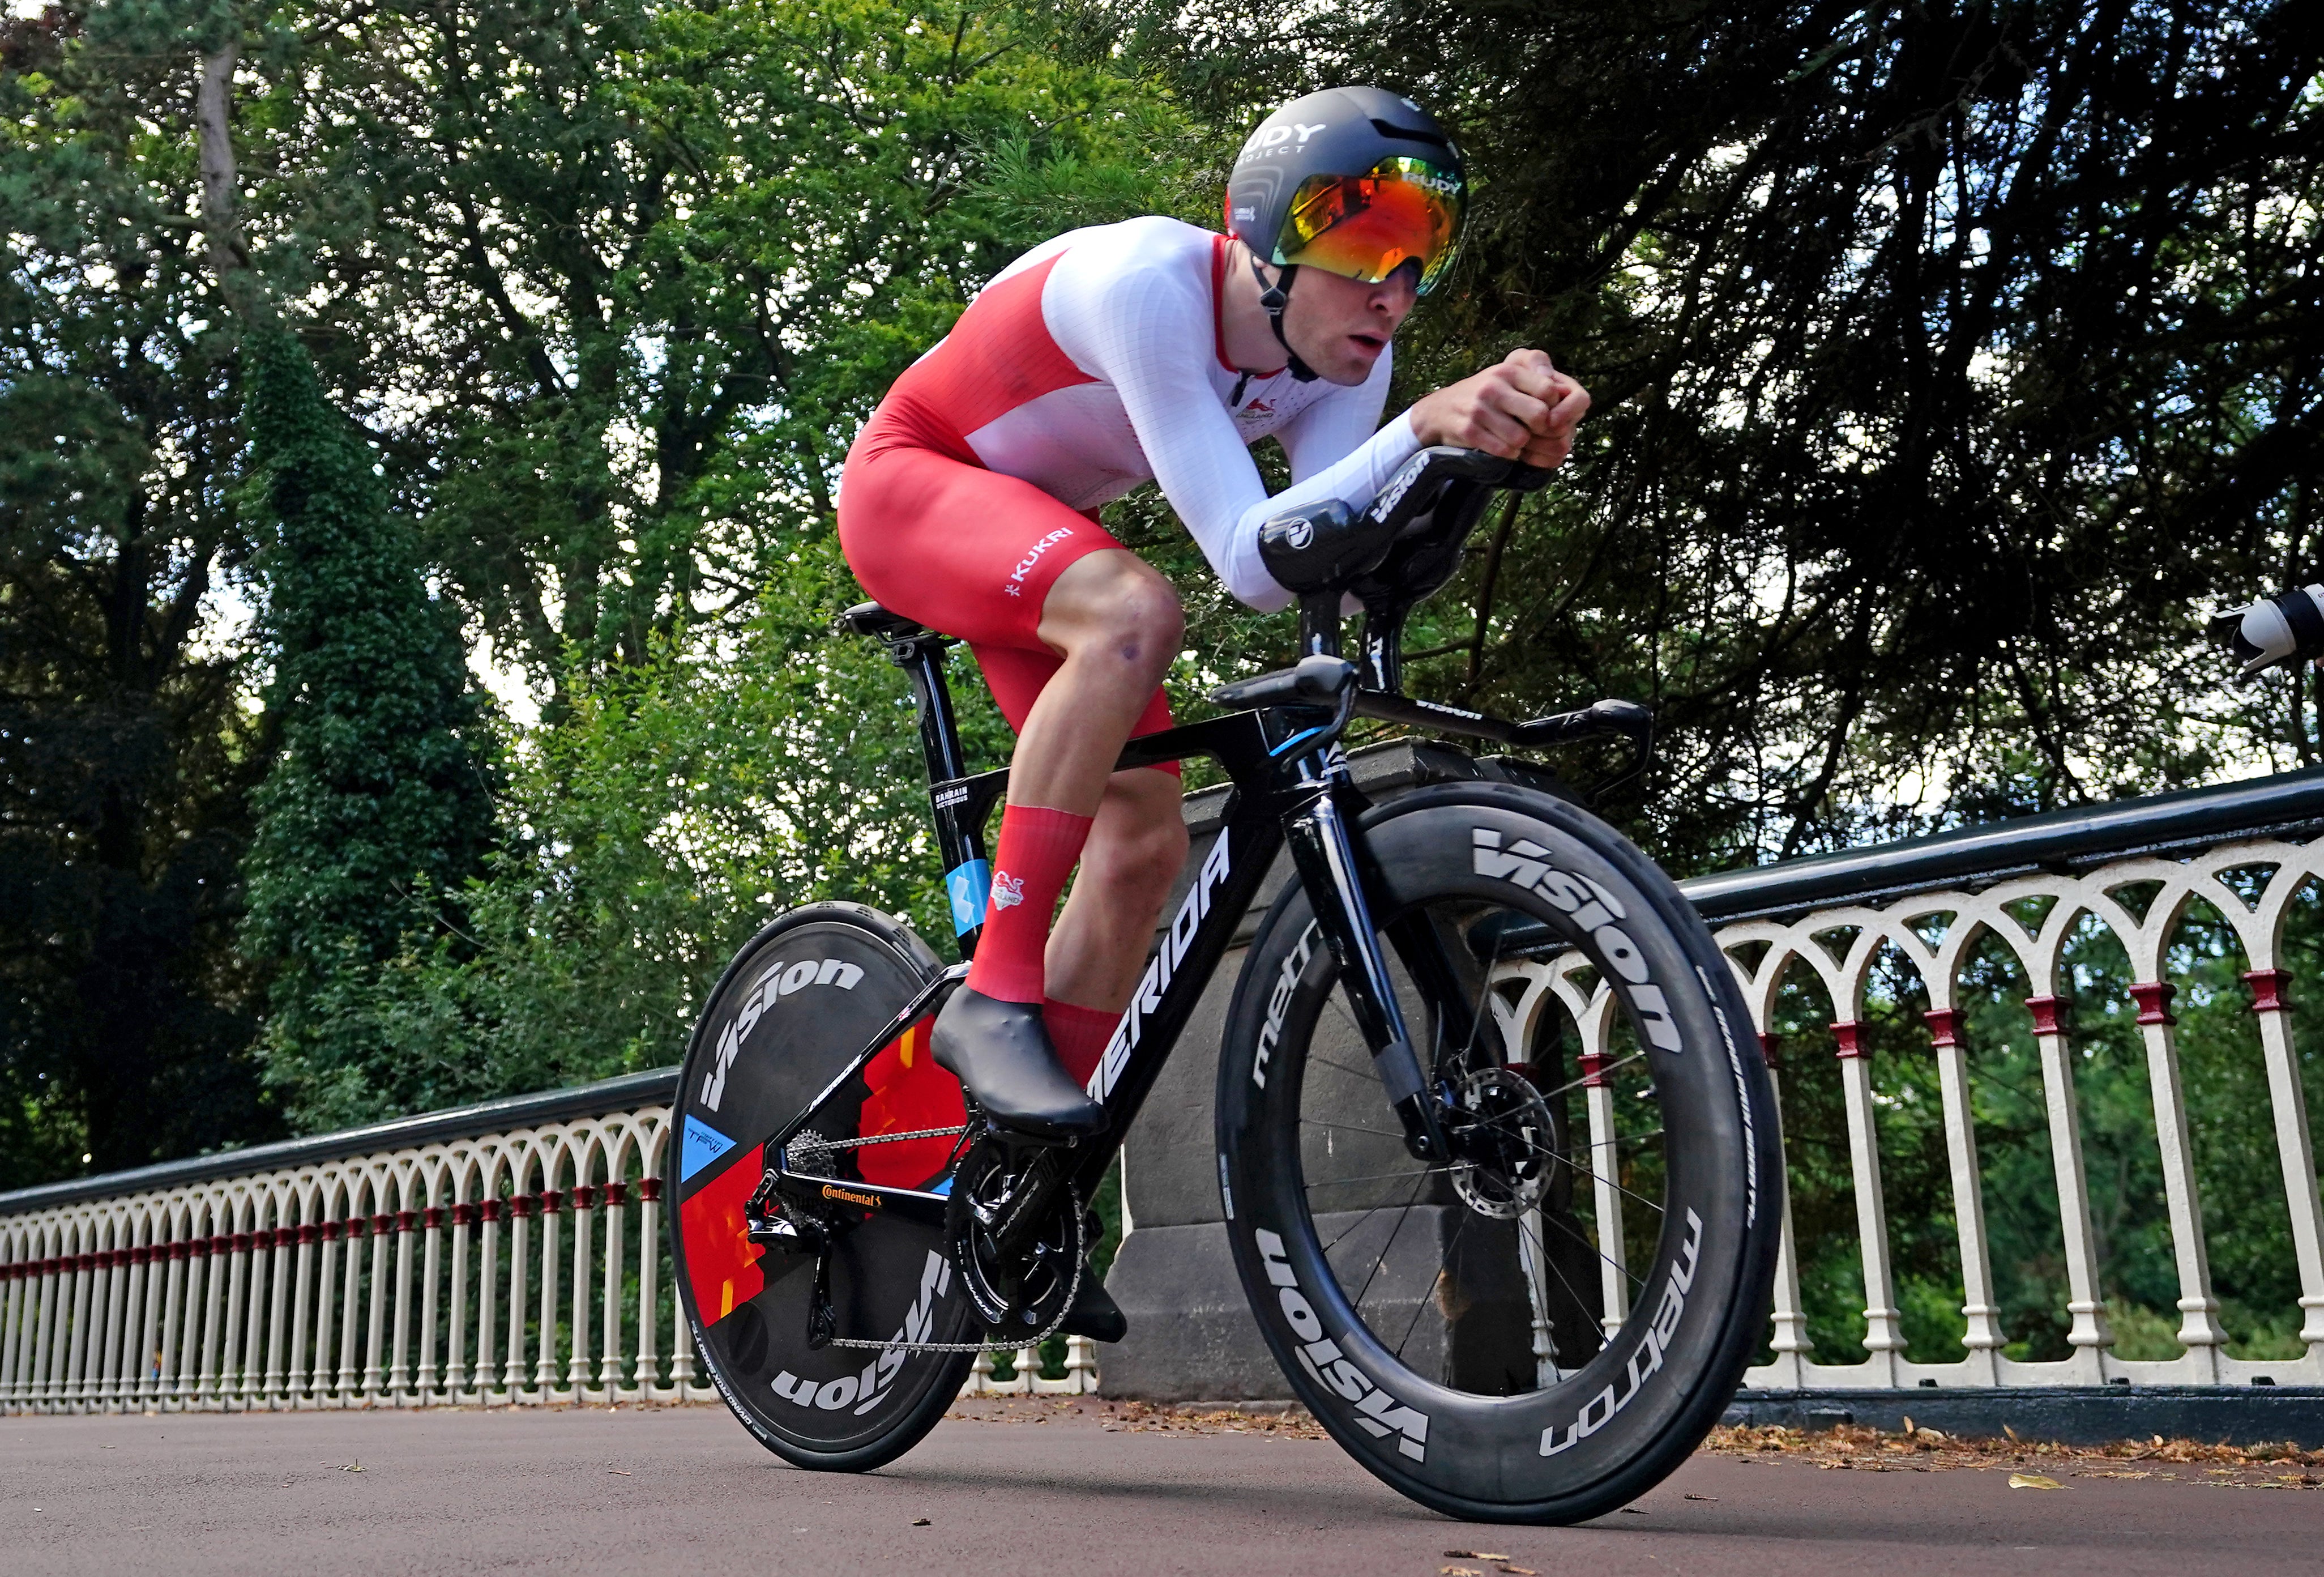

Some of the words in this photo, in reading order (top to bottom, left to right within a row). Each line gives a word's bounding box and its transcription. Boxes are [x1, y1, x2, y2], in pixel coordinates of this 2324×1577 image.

[1240, 123, 1326, 157] UDY
[1011, 527, 1074, 582] KUKRI
[935, 786, 968, 803] BAHRAIN
[822, 1184, 874, 1207] Continental
